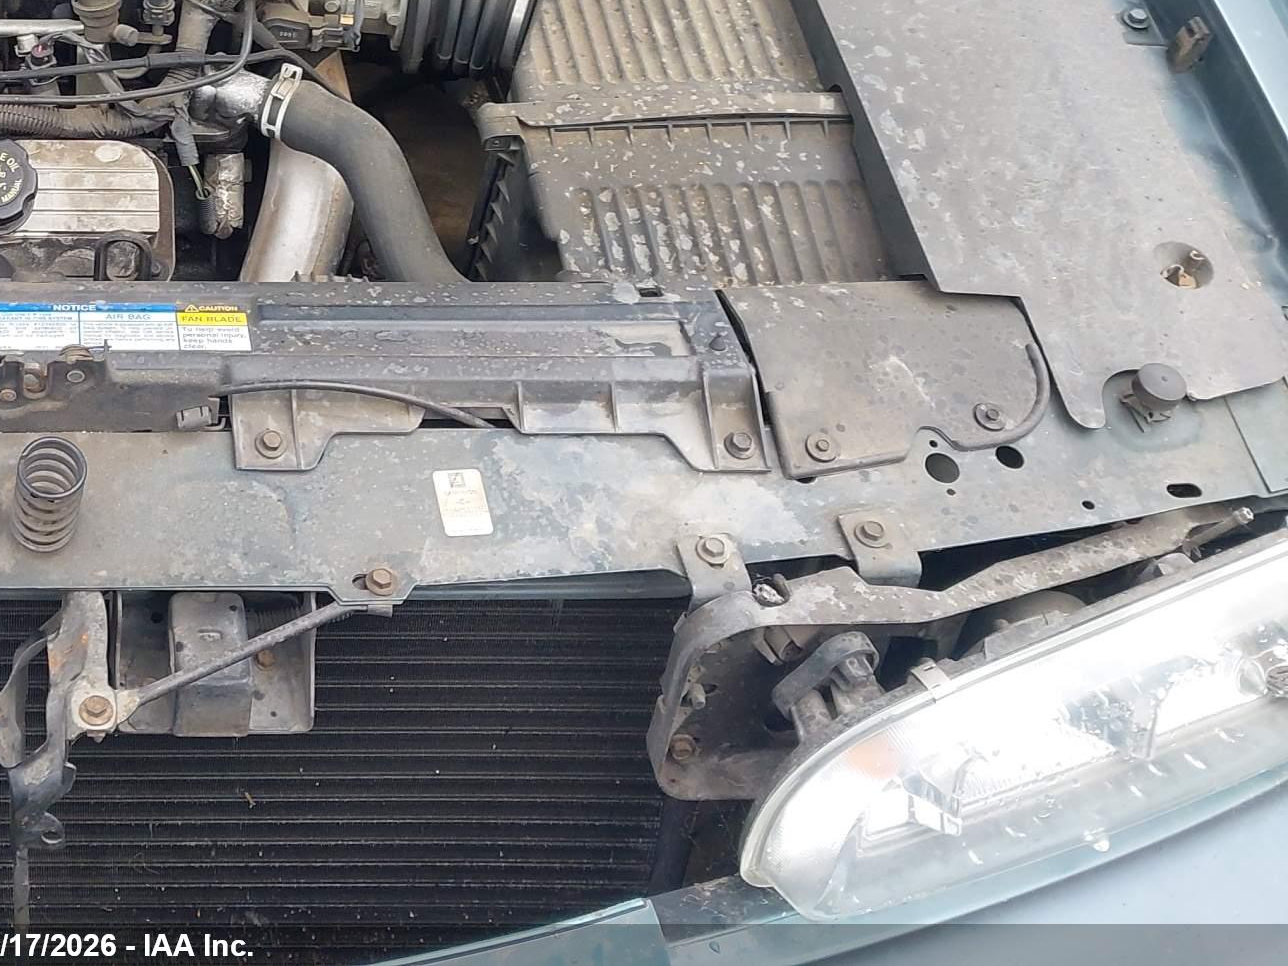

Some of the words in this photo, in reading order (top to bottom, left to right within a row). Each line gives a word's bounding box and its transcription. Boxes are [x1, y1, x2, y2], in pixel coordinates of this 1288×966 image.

[6, 157, 21, 173] OIL
[0, 178, 23, 203] MANUAL
[181, 315, 204, 323] FAN
[205, 315, 243, 323] BLADE
